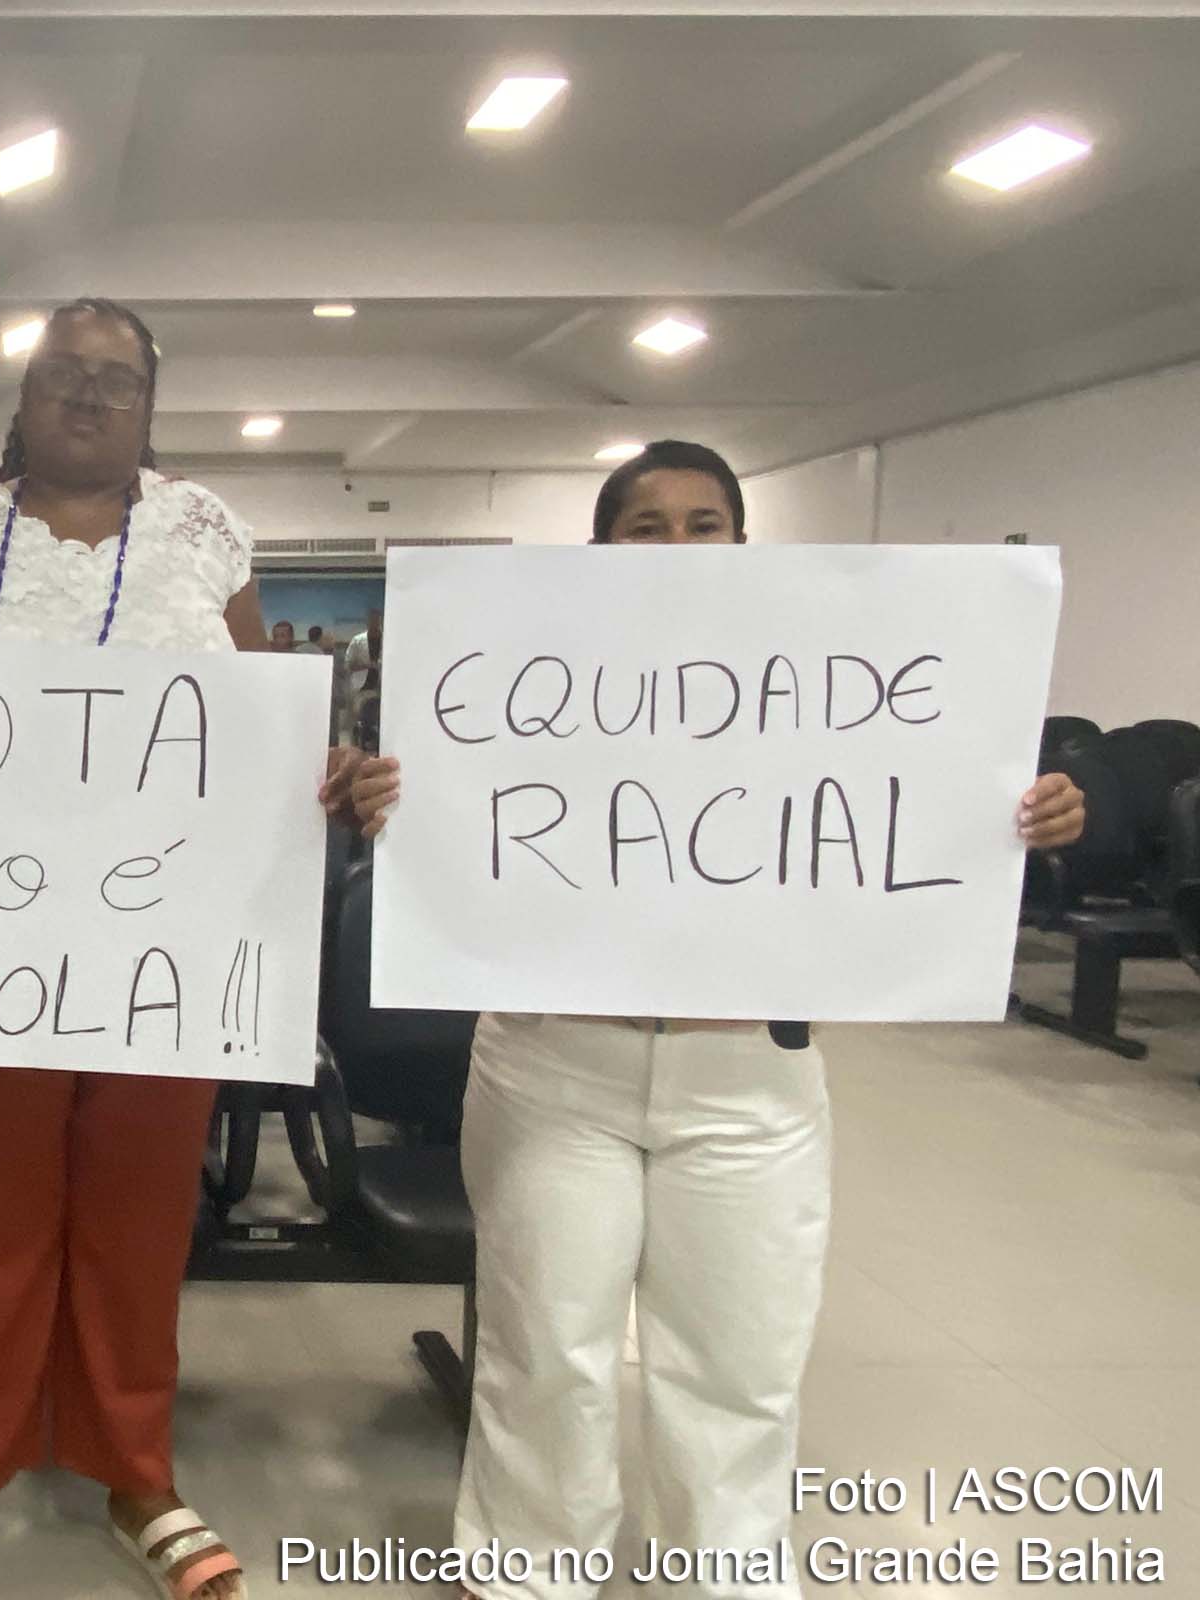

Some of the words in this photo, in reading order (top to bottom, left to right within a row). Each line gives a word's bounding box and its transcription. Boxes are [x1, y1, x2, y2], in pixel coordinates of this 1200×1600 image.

[434, 652, 943, 744] EQUIDADE
[100, 838, 186, 911] é
[490, 776, 963, 892] RACIAL
